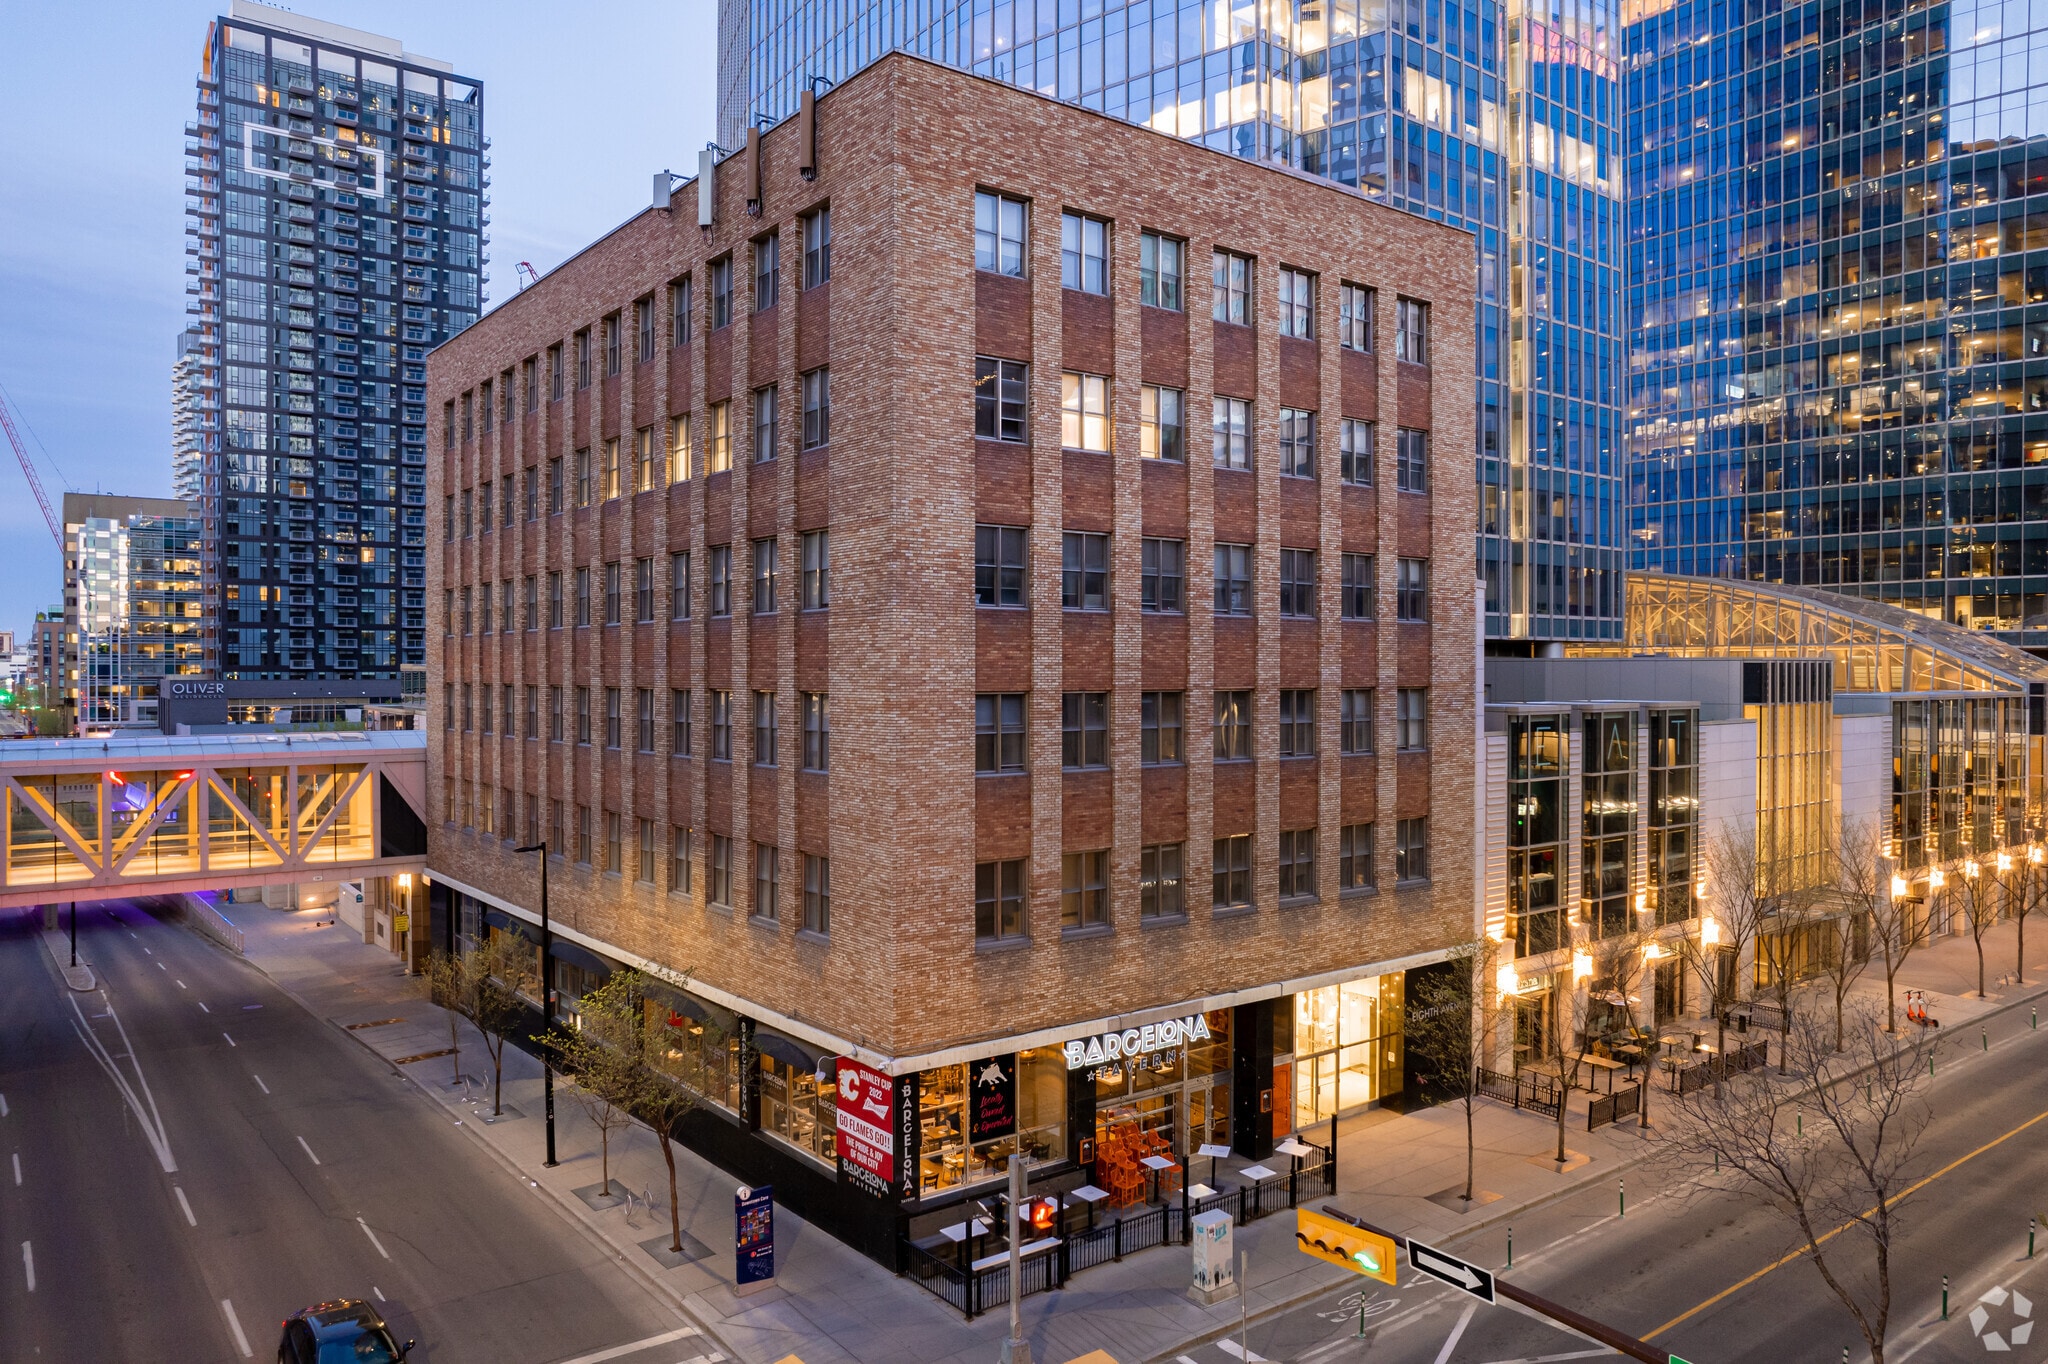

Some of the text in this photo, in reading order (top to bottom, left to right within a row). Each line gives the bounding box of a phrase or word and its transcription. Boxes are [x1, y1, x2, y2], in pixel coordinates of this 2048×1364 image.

[172, 683, 224, 694] OLIVER
[1411, 1006, 1439, 1022] EIGHTH
[1063, 1013, 1211, 1070] BARCELONA
[1099, 1050, 1177, 1078] TAVERN
[860, 1069, 892, 1091] STANLEY CUP
[869, 1086, 883, 1101] 2022
[980, 1092, 1004, 1109] Locally
[981, 1105, 1005, 1119] Owned
[840, 1113, 890, 1150] GO FLAMES GO!!
[981, 1115, 1013, 1133] Operated
[846, 1135, 883, 1163] THE PRIDE & JOY
[902, 1085, 913, 1191] BARCELONA
[850, 1148, 879, 1171] OF OUR CITY
[842, 1157, 889, 1194] BARCELONA
[852, 1177, 878, 1197] TAVERN
